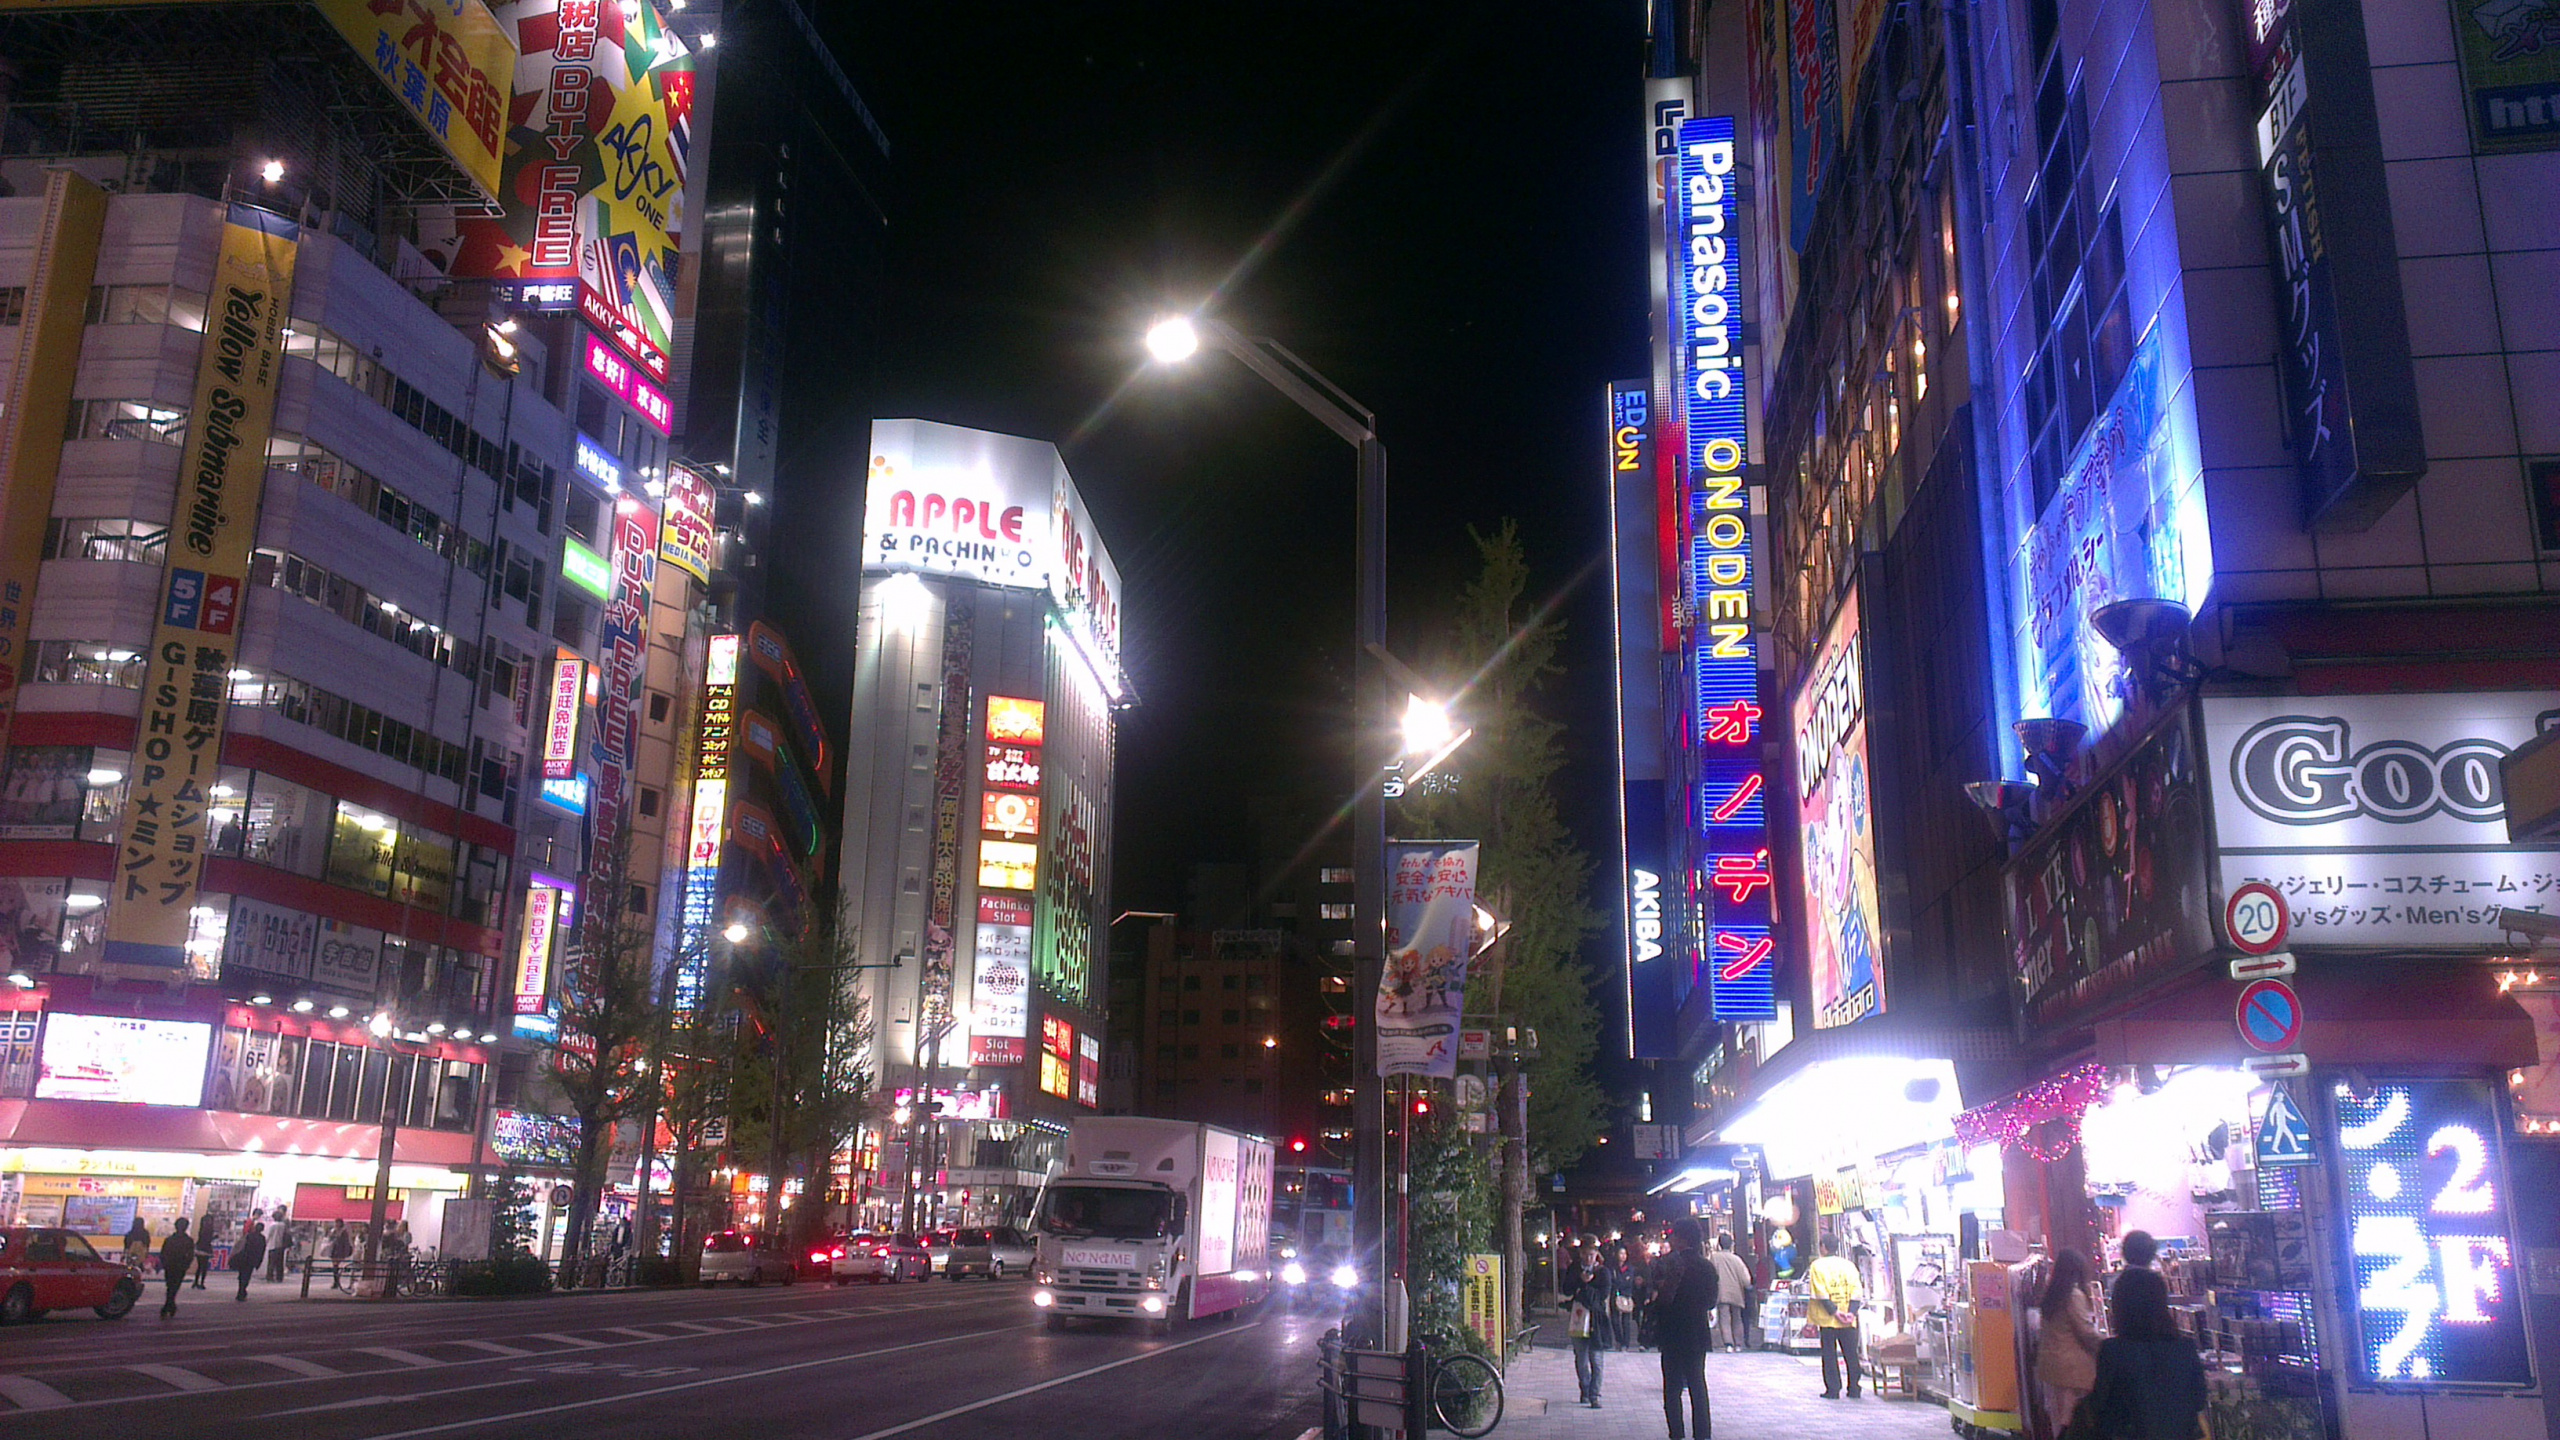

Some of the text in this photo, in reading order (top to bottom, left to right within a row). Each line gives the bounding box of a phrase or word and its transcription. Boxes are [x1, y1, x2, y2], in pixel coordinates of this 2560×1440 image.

[375, 29, 451, 140] 秋葉原
[546, 66, 592, 162] DUTY
[2271, 74, 2297, 145] B1F
[532, 166, 581, 267] FREE
[636, 195, 663, 231] ONE
[1690, 142, 1742, 400] Panasonic
[584, 293, 615, 328] AKKY
[257, 297, 279, 387] HOBBY BASE
[187, 285, 264, 556] Yellow Submarine
[889, 489, 1023, 543] APPLE
[663, 542, 689, 561] MEDIA
[1704, 438, 1750, 658] ONODEN
[172, 577, 196, 620] 5F
[208, 585, 233, 626] 4F
[1684, 560, 1695, 628] Electronics
[604, 518, 647, 757] DUTY FREE
[707, 686, 732, 697] ゲーム
[708, 699, 729, 710] CD
[703, 726, 730, 738] アニメ
[1799, 631, 1863, 801] ONODEN
[702, 740, 727, 751] コミック
[702, 754, 725, 764] ホビー
[545, 760, 569, 769] AKKY
[2230, 710, 2560, 825] Goo
[372, 846, 394, 867] Yello
[1708, 700, 1775, 980] オノデン
[980, 898, 1030, 912] Pachinko
[2026, 846, 2065, 938] LVE
[993, 912, 1016, 923] Slot
[1633, 868, 1663, 963] AKIBA
[2239, 901, 2275, 936] 20
[527, 918, 546, 953] DUTY
[523, 956, 543, 993] FREE
[516, 996, 540, 1005] AKKY
[517, 1004, 537, 1013] ONE
[972, 1051, 1023, 1064] Pachinko
[986, 1038, 1009, 1049] Slot
[2428, 1124, 2511, 1324] 2F
[1065, 1251, 1131, 1266] NO NAME
